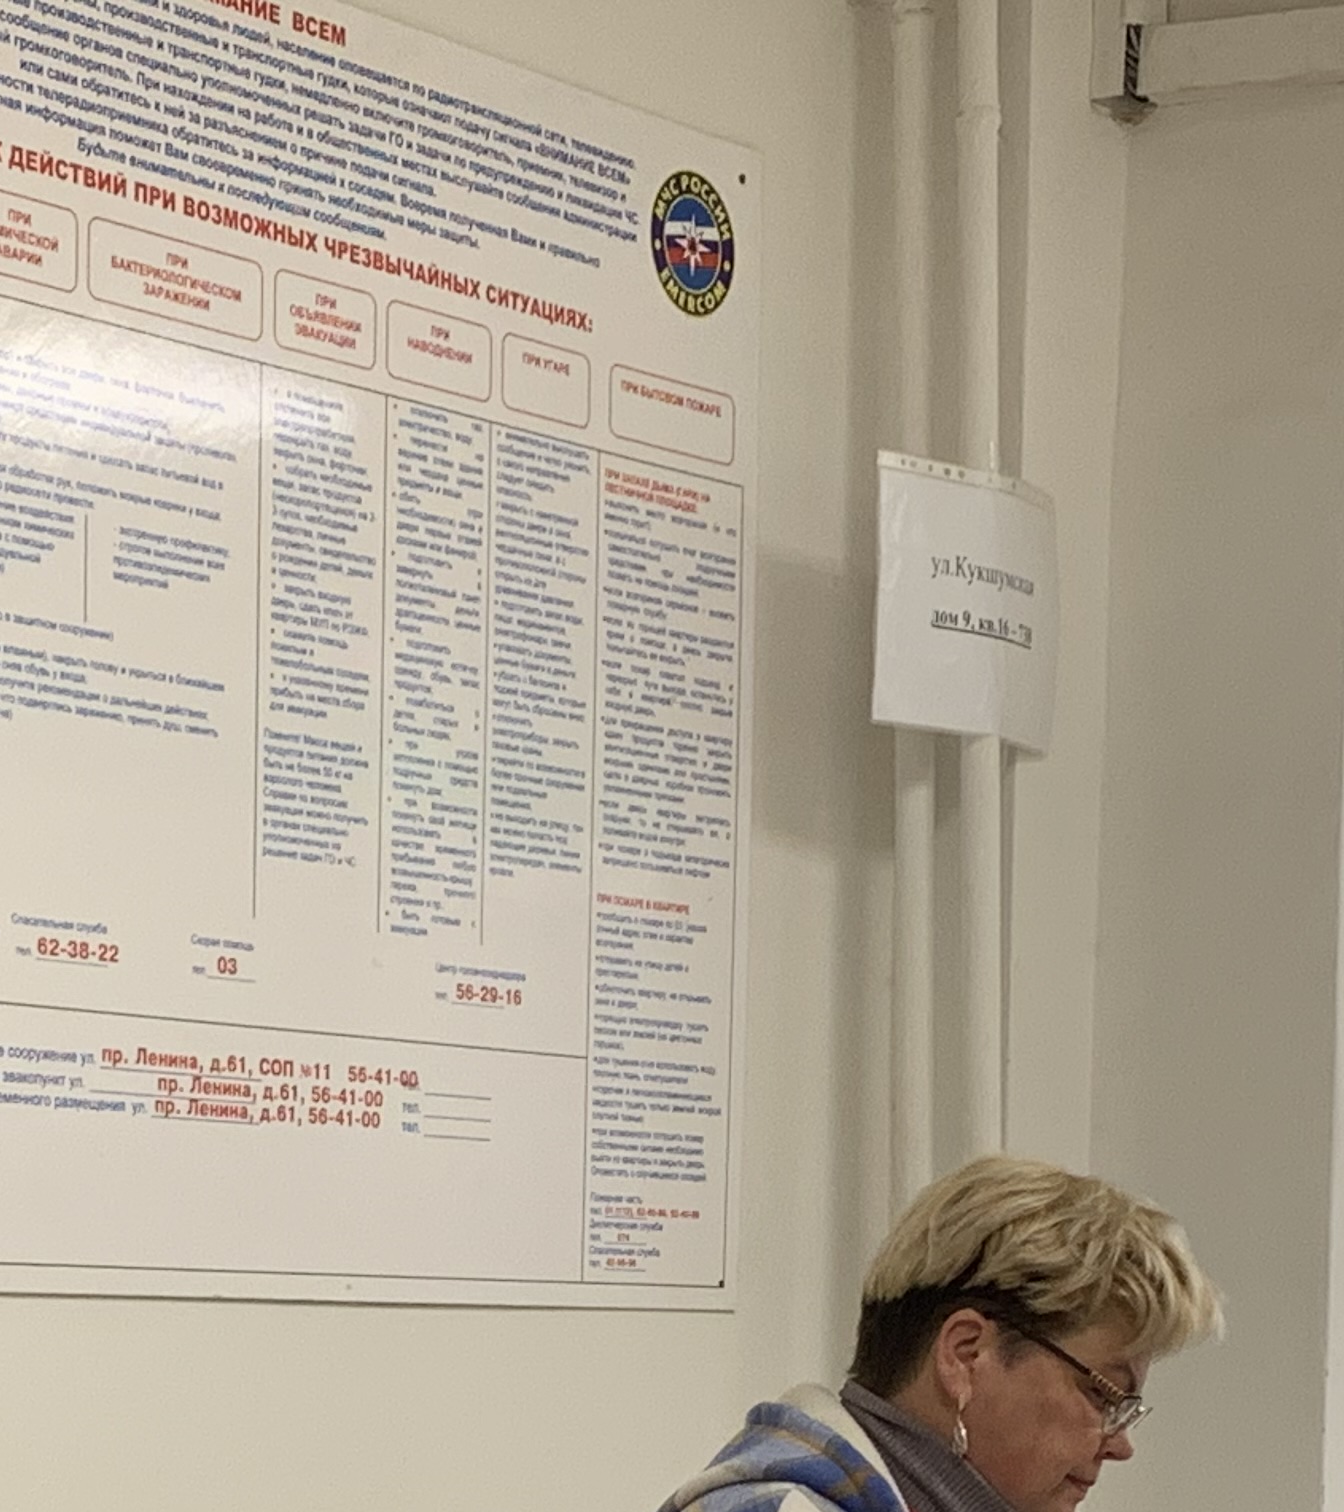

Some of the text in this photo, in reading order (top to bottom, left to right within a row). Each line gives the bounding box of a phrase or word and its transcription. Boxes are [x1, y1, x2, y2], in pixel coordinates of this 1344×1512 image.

[291, 10, 346, 47] ВСЕМ
[7, 207, 32, 227] ПРИ
[654, 174, 732, 241] МЧС РОССИИ
[7, 144, 127, 198] ДЕЙСТВИЙ
[133, 181, 176, 212] ПРИ
[182, 195, 318, 253] ВОЗМОЖНЫХ
[323, 236, 481, 300] ЧРЕЗВЫЧАЙНЫХ
[485, 284, 593, 333] СИТУАЦИЯХ:
[166, 252, 189, 269] ПРИ
[110, 254, 242, 302] БАКТЕРИОЛОГИЧЕСКОМ
[659, 266, 727, 313] EMERCOM
[142, 281, 210, 311] ЗАРАЖЕНИИ
[314, 292, 337, 310] ПРИ
[294, 322, 357, 350] ЭВАКУАЦИИ
[430, 324, 450, 341] ПРИ
[406, 336, 473, 364] НАВОДНЕНИИ
[36, 936, 119, 963] 62-38-22
[216, 955, 238, 976] 03
[455, 982, 522, 1006] 56-29-16
[101, 1047, 129, 1067] пр.
[134, 1046, 204, 1073] Ленина,
[209, 1054, 253, 1077] д.61,
[258, 1057, 294, 1078] СОП
[347, 1065, 419, 1089] 56-41-00
[157, 1077, 183, 1095] пр.
[189, 1075, 257, 1101] Ленина,
[261, 1082, 305, 1105] д.61,
[310, 1085, 384, 1108] 56-41-00
[153, 1099, 181, 1117] пр.
[186, 1098, 254, 1123] Ленина,
[258, 1104, 302, 1126] д.61,
[307, 1106, 381, 1129] 56-41-00
